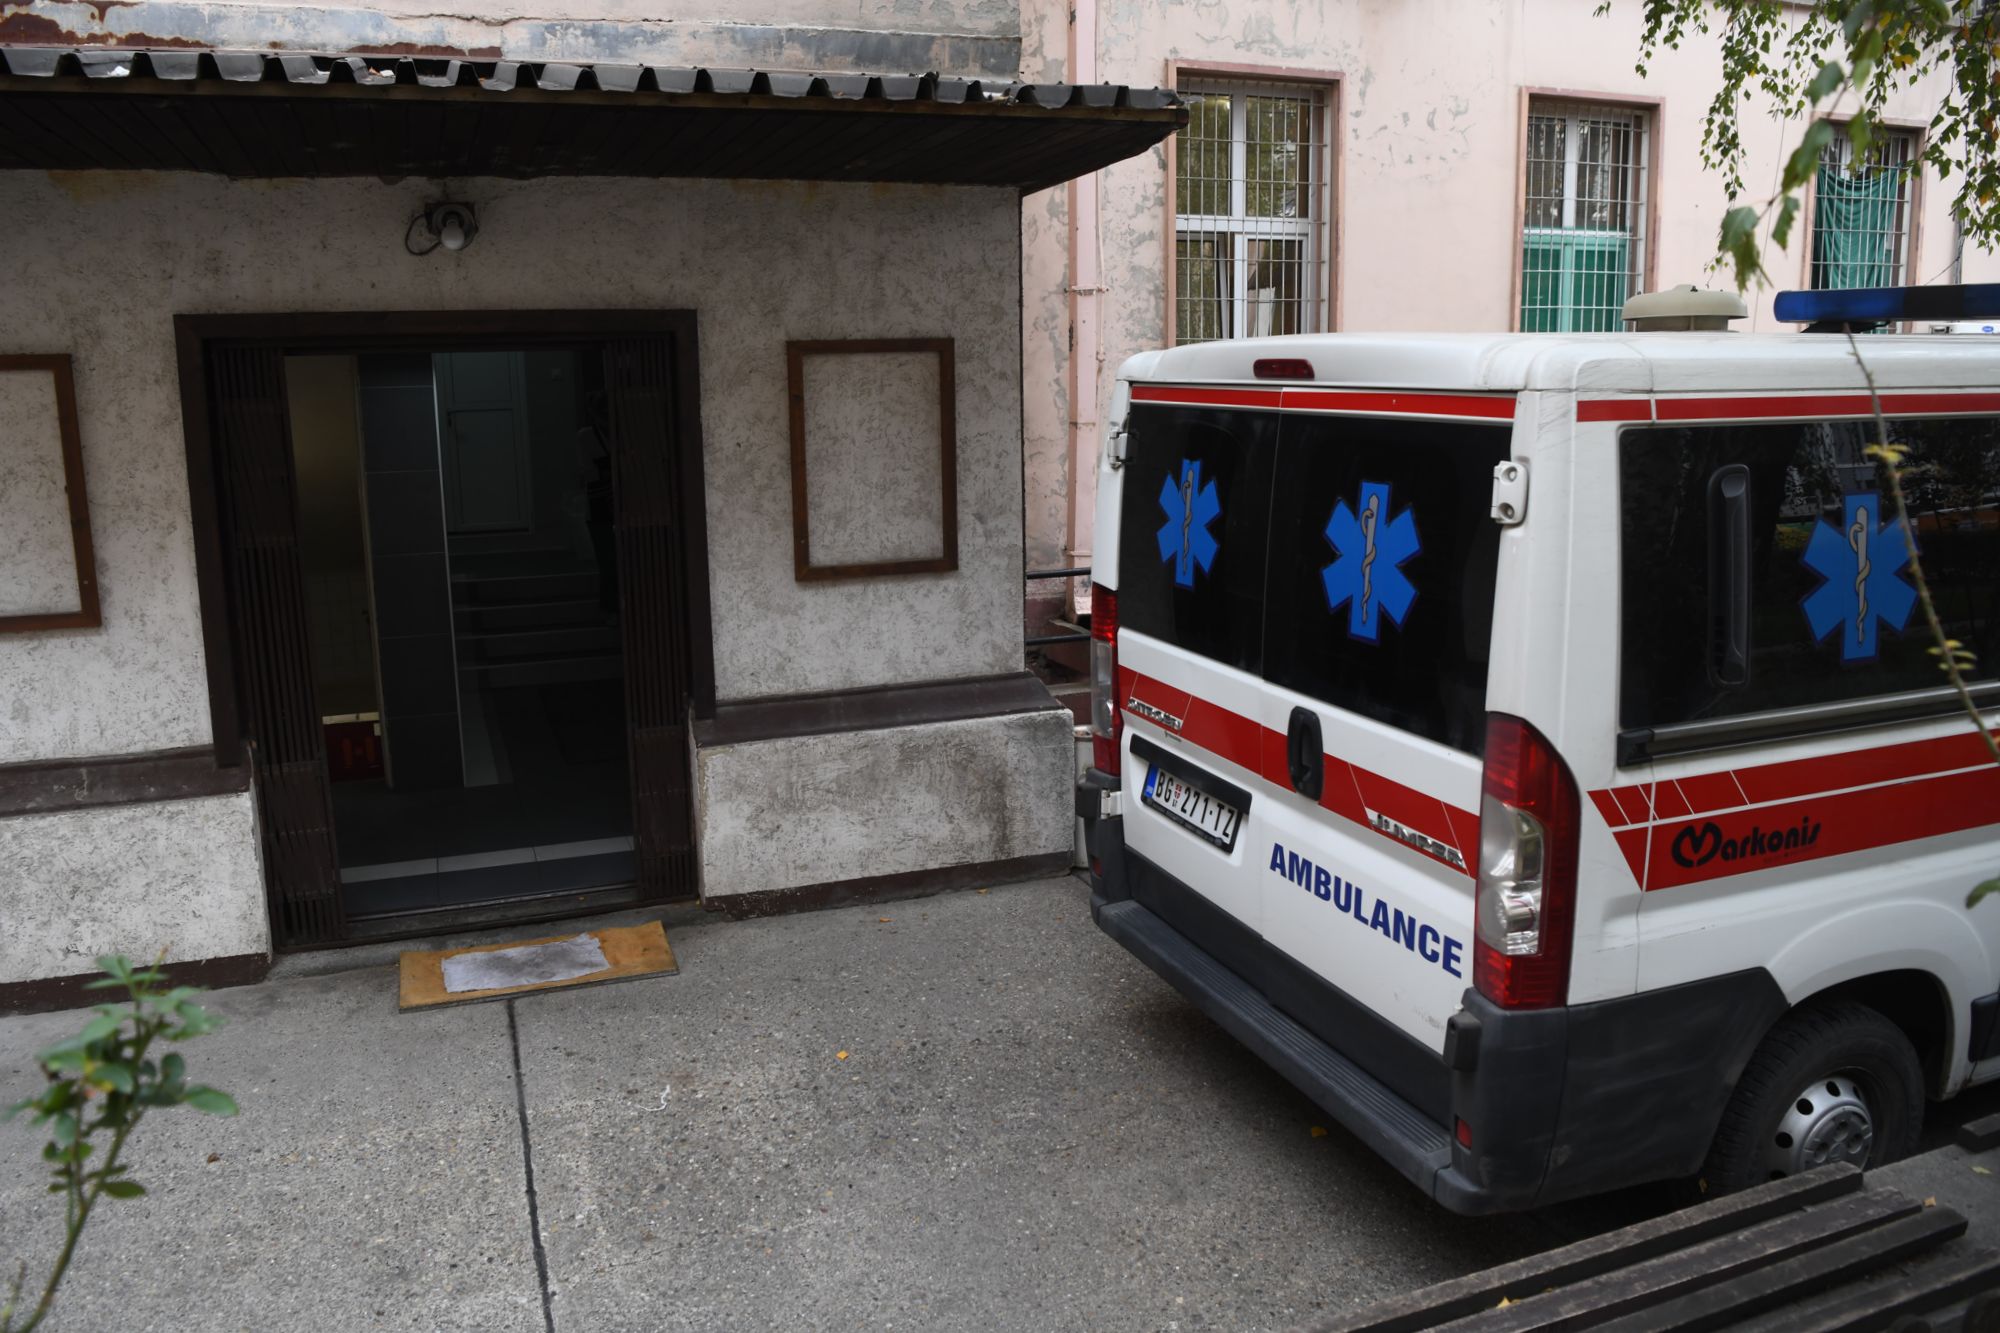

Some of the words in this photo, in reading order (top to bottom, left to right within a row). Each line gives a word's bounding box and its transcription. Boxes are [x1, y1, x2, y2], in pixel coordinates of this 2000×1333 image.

[1156, 771, 1173, 803] BG
[1369, 813, 1464, 868] JUMPER
[1672, 817, 1821, 867] Markonis
[1270, 843, 1463, 979] AMBULANCE
